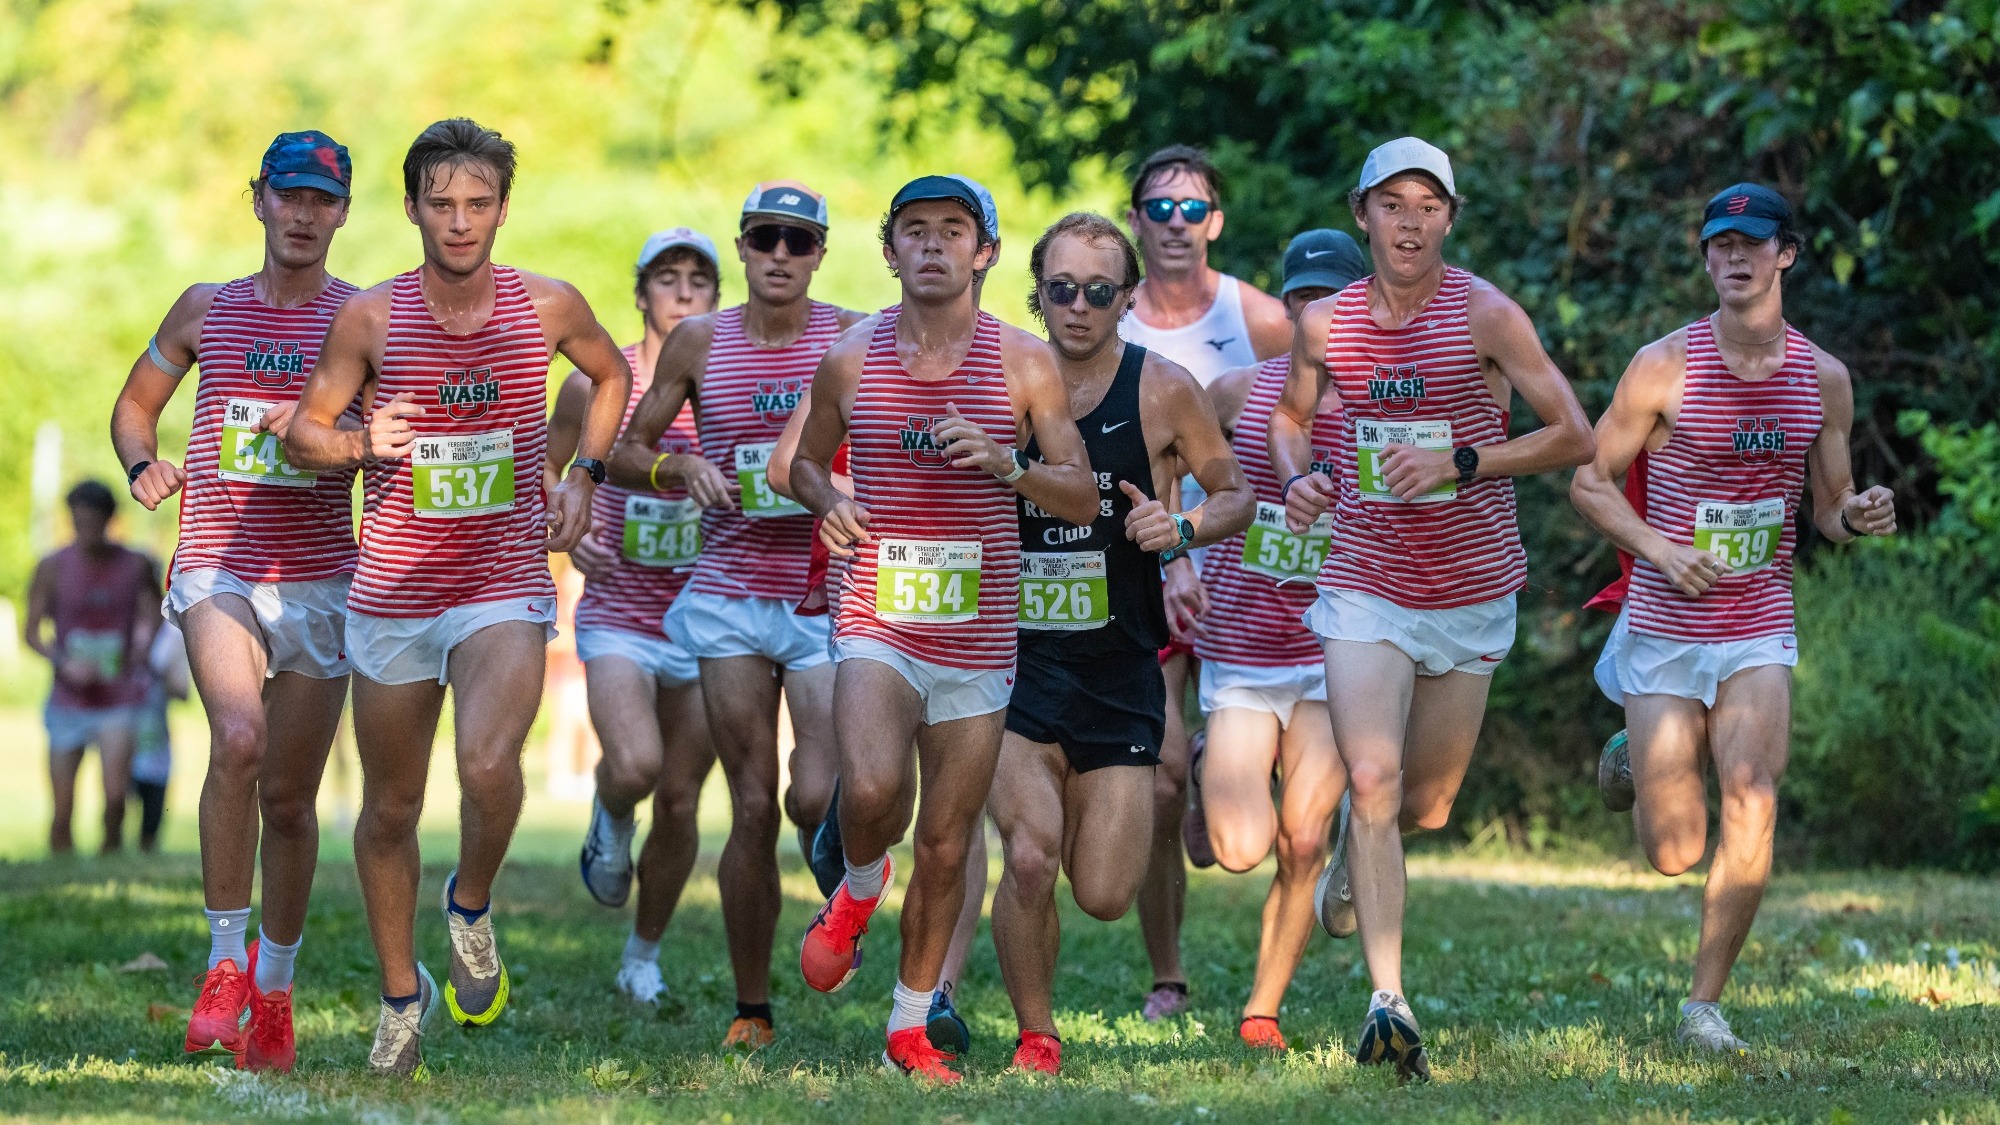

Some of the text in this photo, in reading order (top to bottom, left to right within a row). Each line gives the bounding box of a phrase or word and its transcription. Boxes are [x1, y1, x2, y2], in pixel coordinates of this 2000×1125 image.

[244, 351, 305, 375] WASH
[436, 380, 501, 406] WASH
[1367, 376, 1427, 401] WASH
[231, 404, 250, 422] 5K
[752, 392, 806, 413] WAS
[1362, 426, 1379, 443] 5K
[1731, 430, 1787, 453] WASH
[234, 431, 300, 476] 54
[420, 443, 440, 460] 5K
[452, 451, 468, 461] RUN
[743, 450, 760, 465] 5K
[430, 464, 498, 508] 537
[1259, 507, 1278, 523] 5K
[1705, 508, 1723, 524] 5K
[1733, 518, 1747, 527] RUN
[636, 523, 698, 558] 548
[1043, 525, 1093, 546] Club
[887, 545, 907, 561] 5K
[1258, 530, 1324, 573] 535
[1709, 529, 1770, 568] 539
[918, 556, 934, 566] RUN
[1020, 557, 1032, 573] K
[1043, 568, 1058, 577] RUN
[893, 571, 965, 612] 534
[1023, 582, 1092, 620] 526
